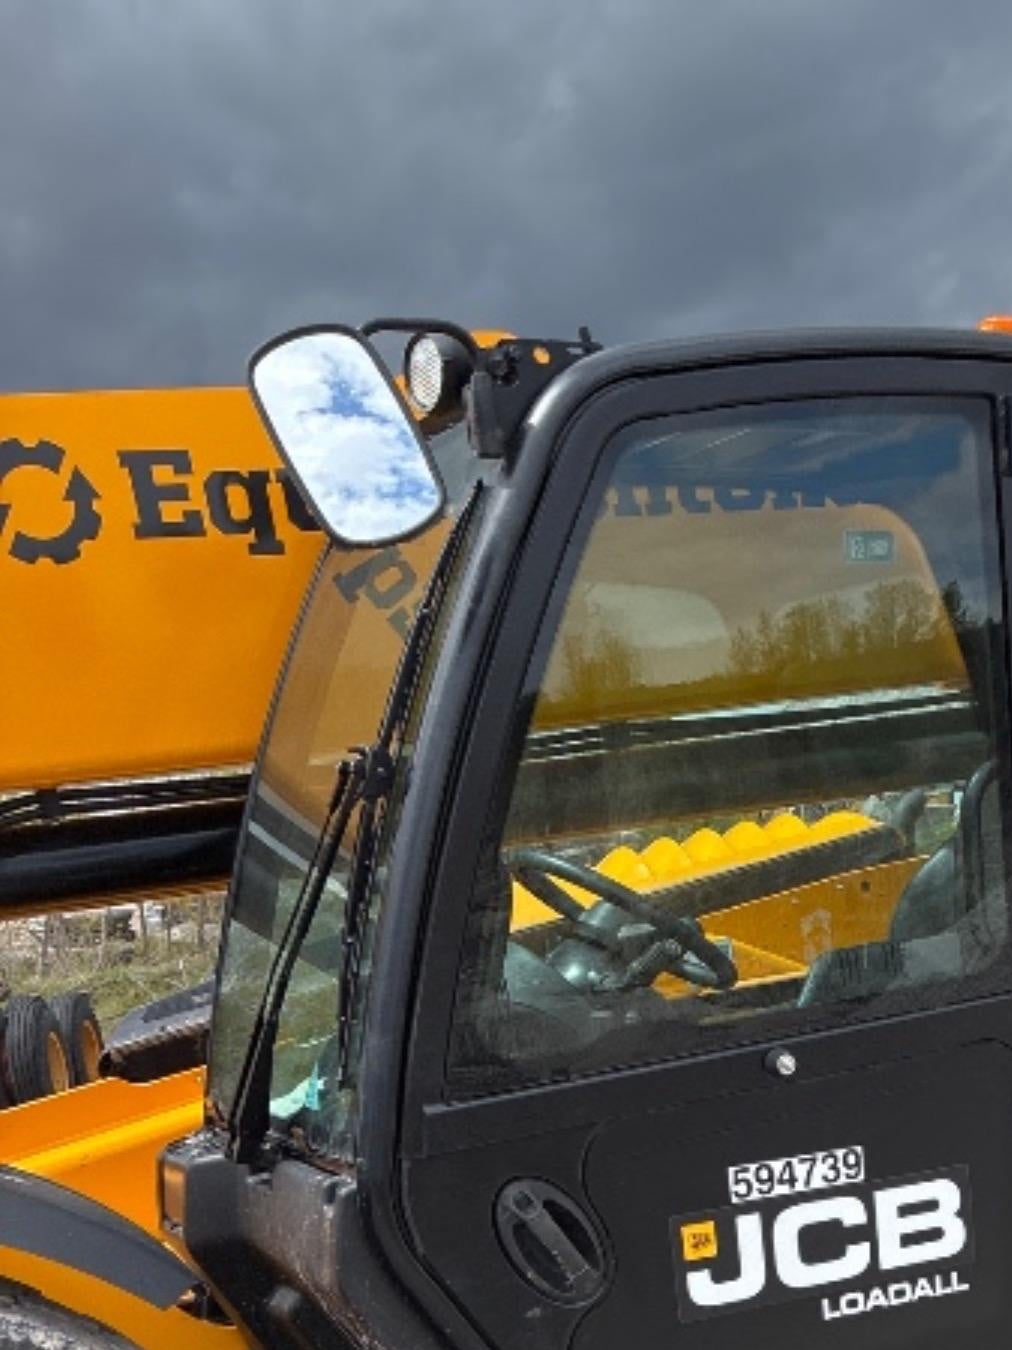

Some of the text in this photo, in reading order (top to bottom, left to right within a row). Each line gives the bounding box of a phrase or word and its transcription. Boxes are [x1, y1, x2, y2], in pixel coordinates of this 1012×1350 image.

[732, 1148, 863, 1198] 594739
[686, 1178, 967, 1306] JCB
[821, 1271, 970, 1321] LOADALL
